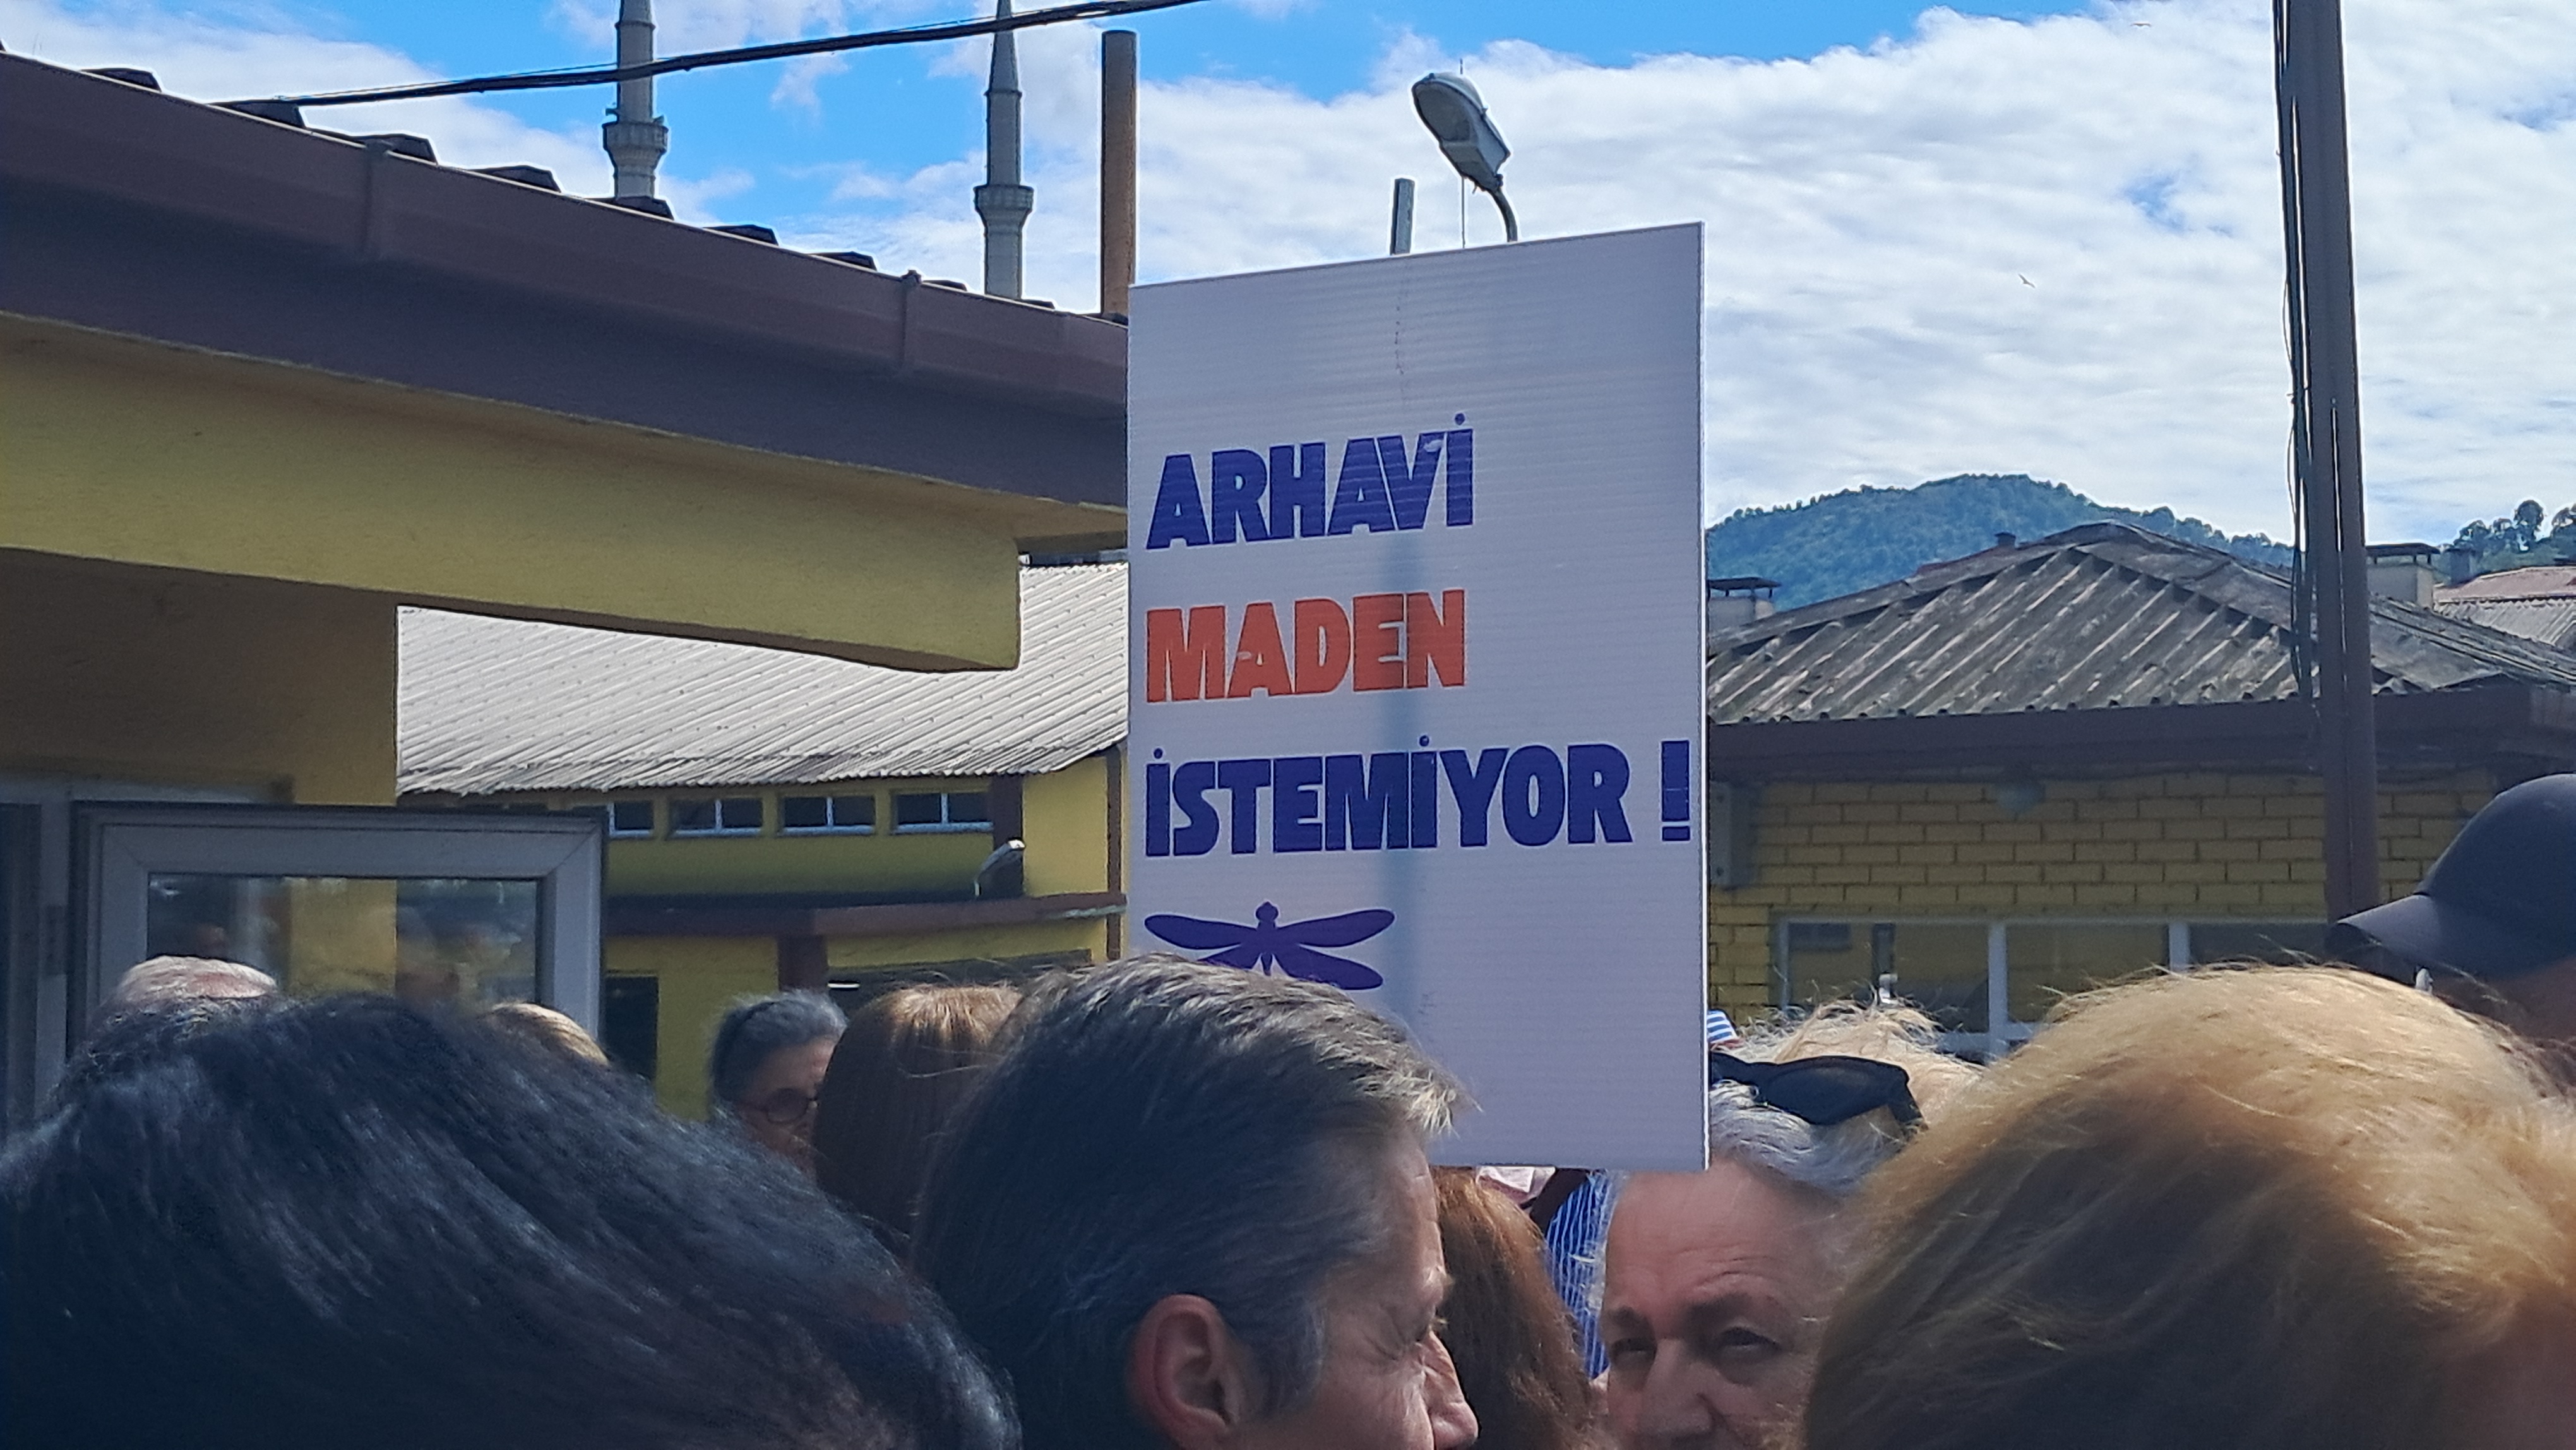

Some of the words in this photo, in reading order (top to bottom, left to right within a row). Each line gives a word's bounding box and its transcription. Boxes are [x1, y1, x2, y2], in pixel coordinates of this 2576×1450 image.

[1146, 412, 1474, 549] ARHAVİ
[1146, 589, 1465, 703] MADEN
[1145, 734, 1632, 857] İSTEMİYOR
[1661, 740, 1691, 842] !
